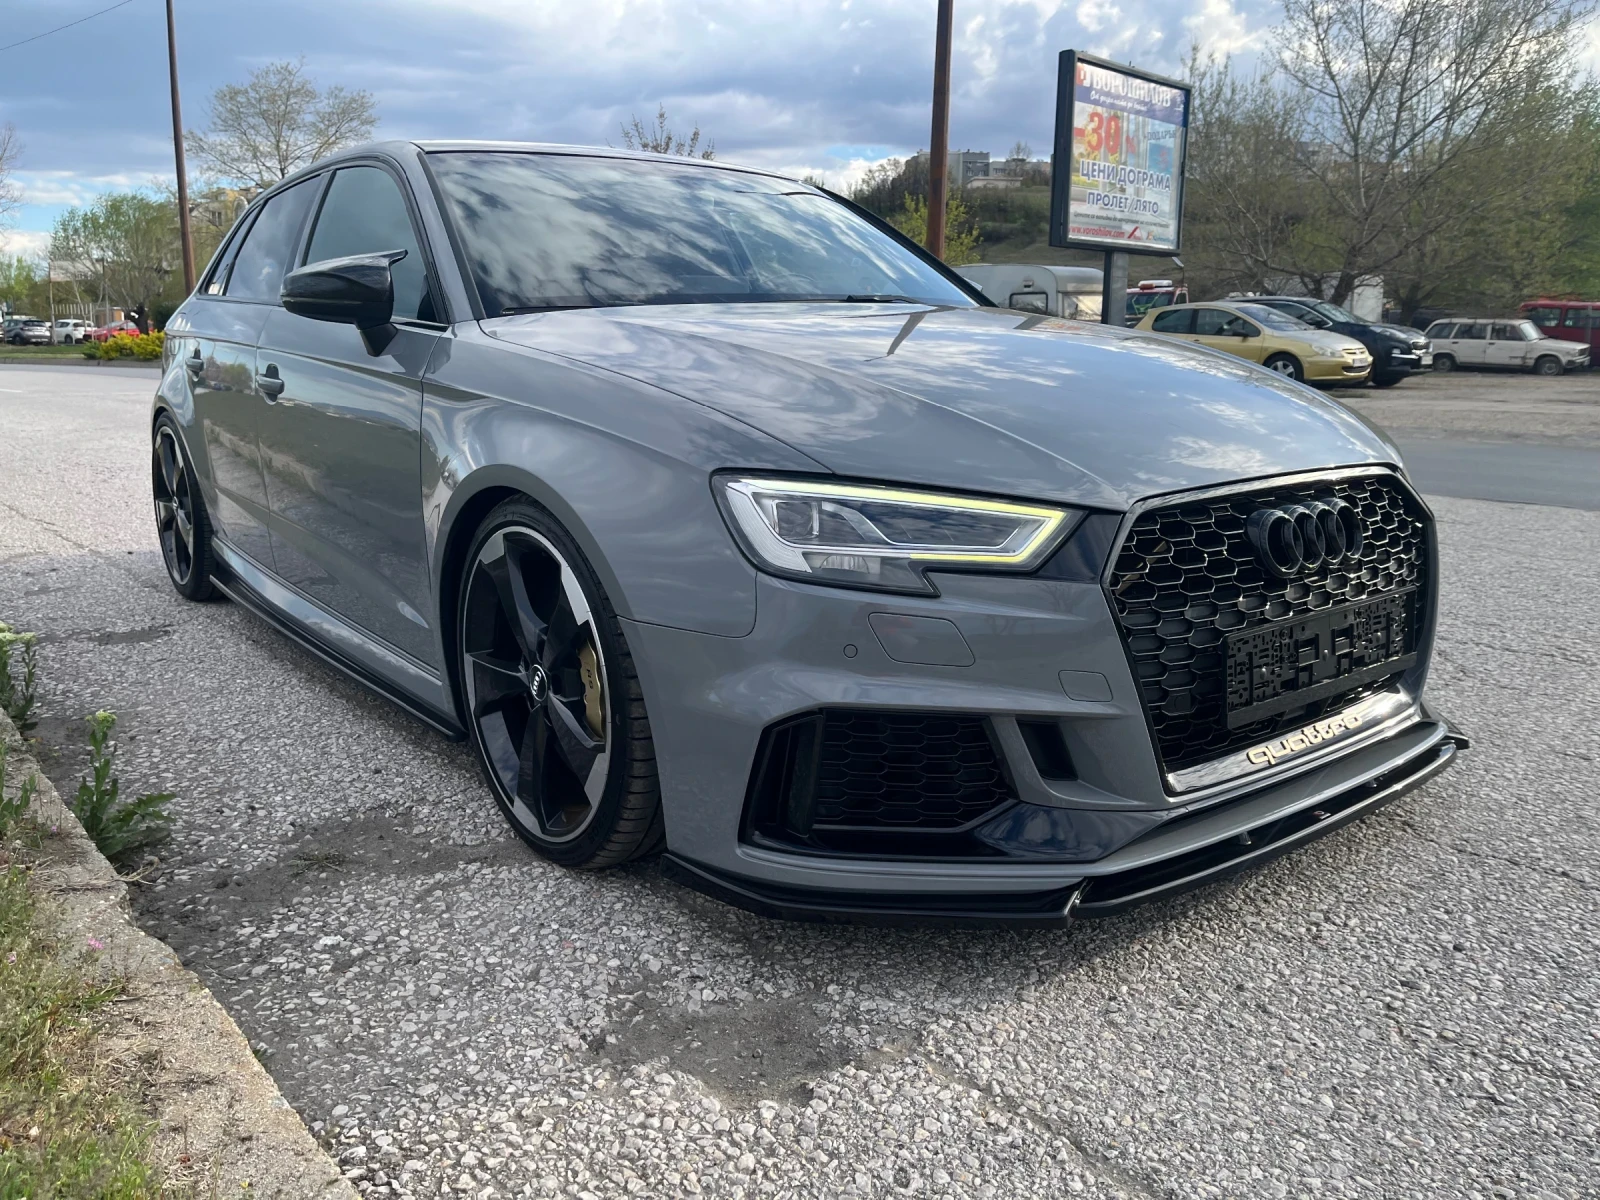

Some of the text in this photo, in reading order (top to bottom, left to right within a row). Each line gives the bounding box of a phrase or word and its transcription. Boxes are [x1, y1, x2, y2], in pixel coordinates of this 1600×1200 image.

[1081, 160, 1171, 191] ЦЕНИ ДОГРАМА
[1087, 192, 1159, 214] ПРОЛЕТ/ЛЯТО
[1246, 713, 1363, 765] quattro
